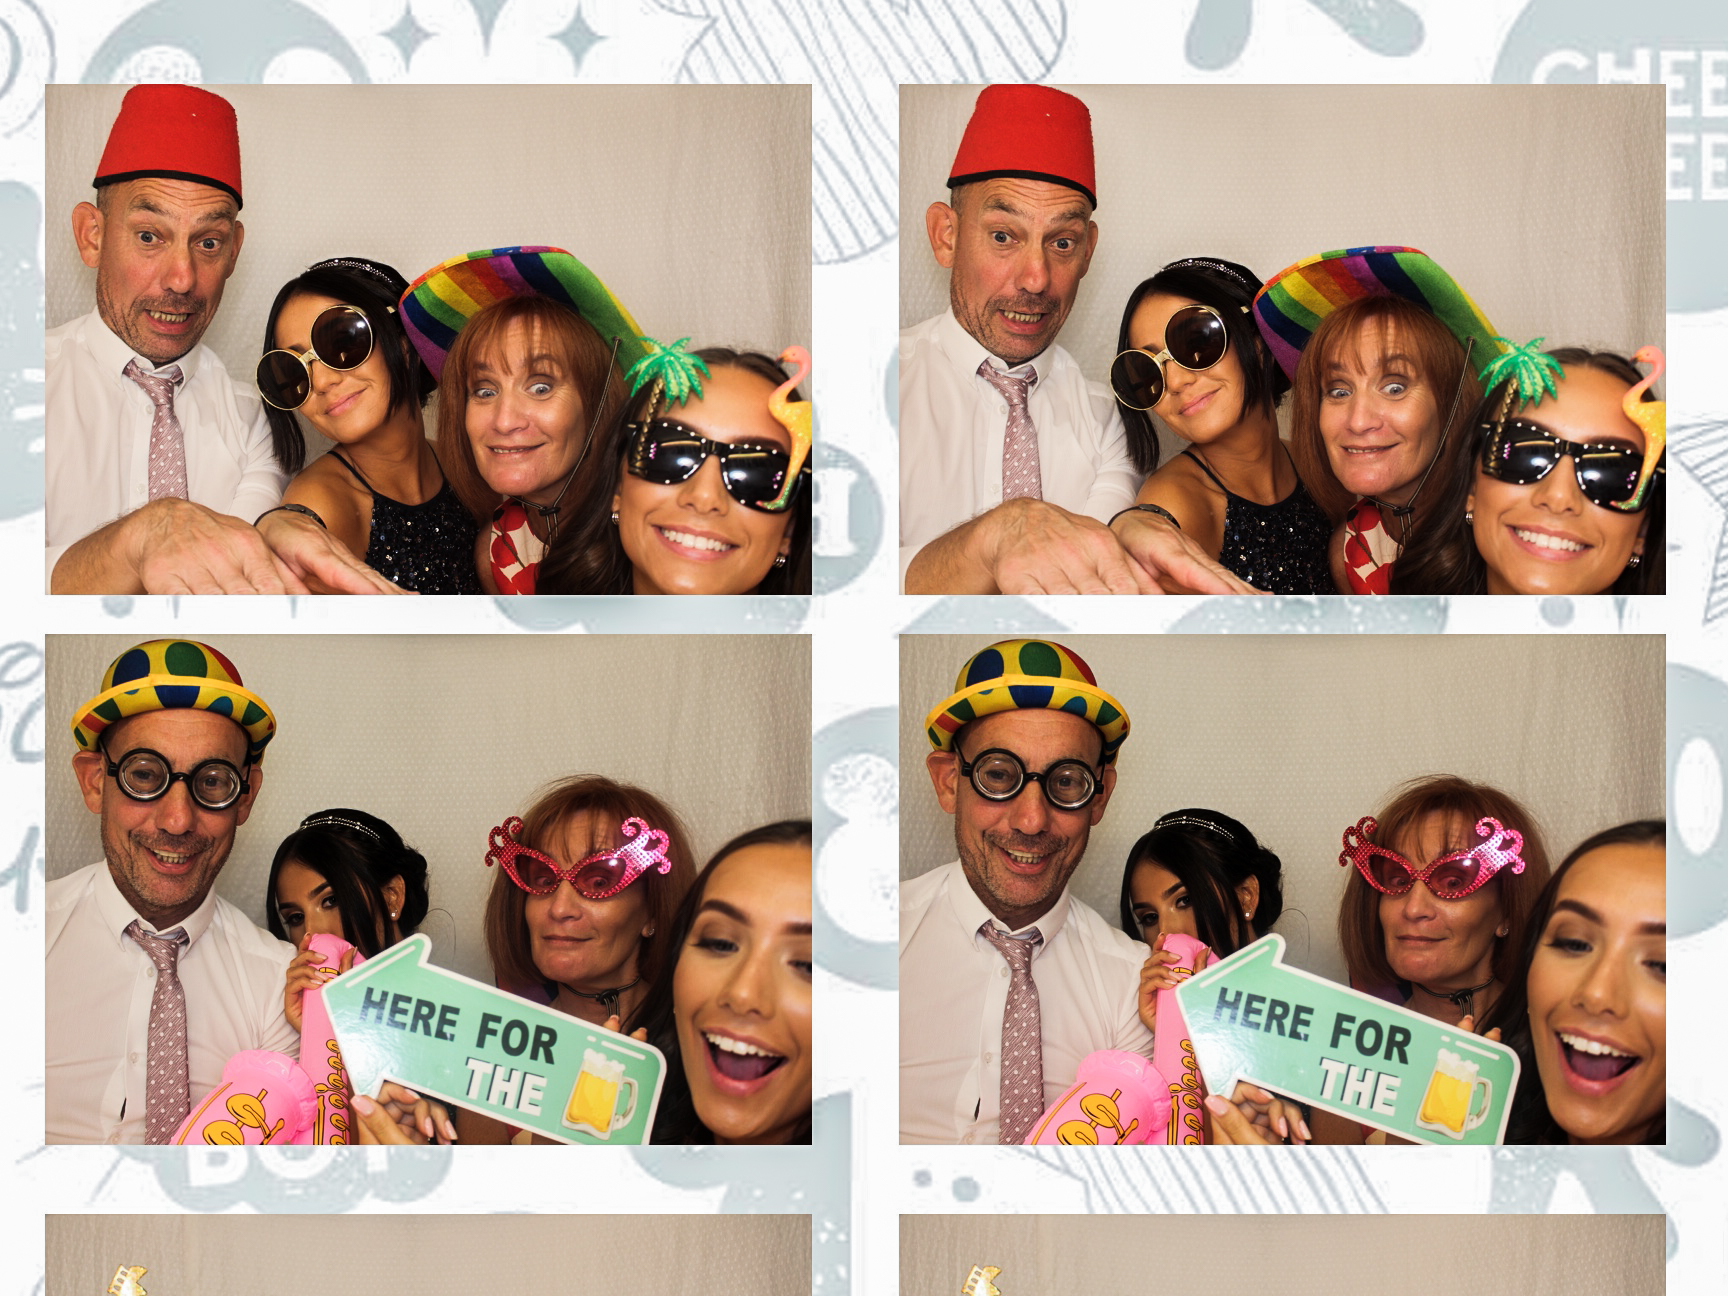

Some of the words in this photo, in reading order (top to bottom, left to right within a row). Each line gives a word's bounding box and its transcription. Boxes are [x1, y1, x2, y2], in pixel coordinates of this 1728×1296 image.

[359, 986, 461, 1043] HERE
[475, 1012, 559, 1066] FOR
[1213, 986, 1315, 1043] HERE
[1329, 1012, 1413, 1066] FOR
[464, 1056, 548, 1117] THE
[1318, 1056, 1402, 1117] THE
